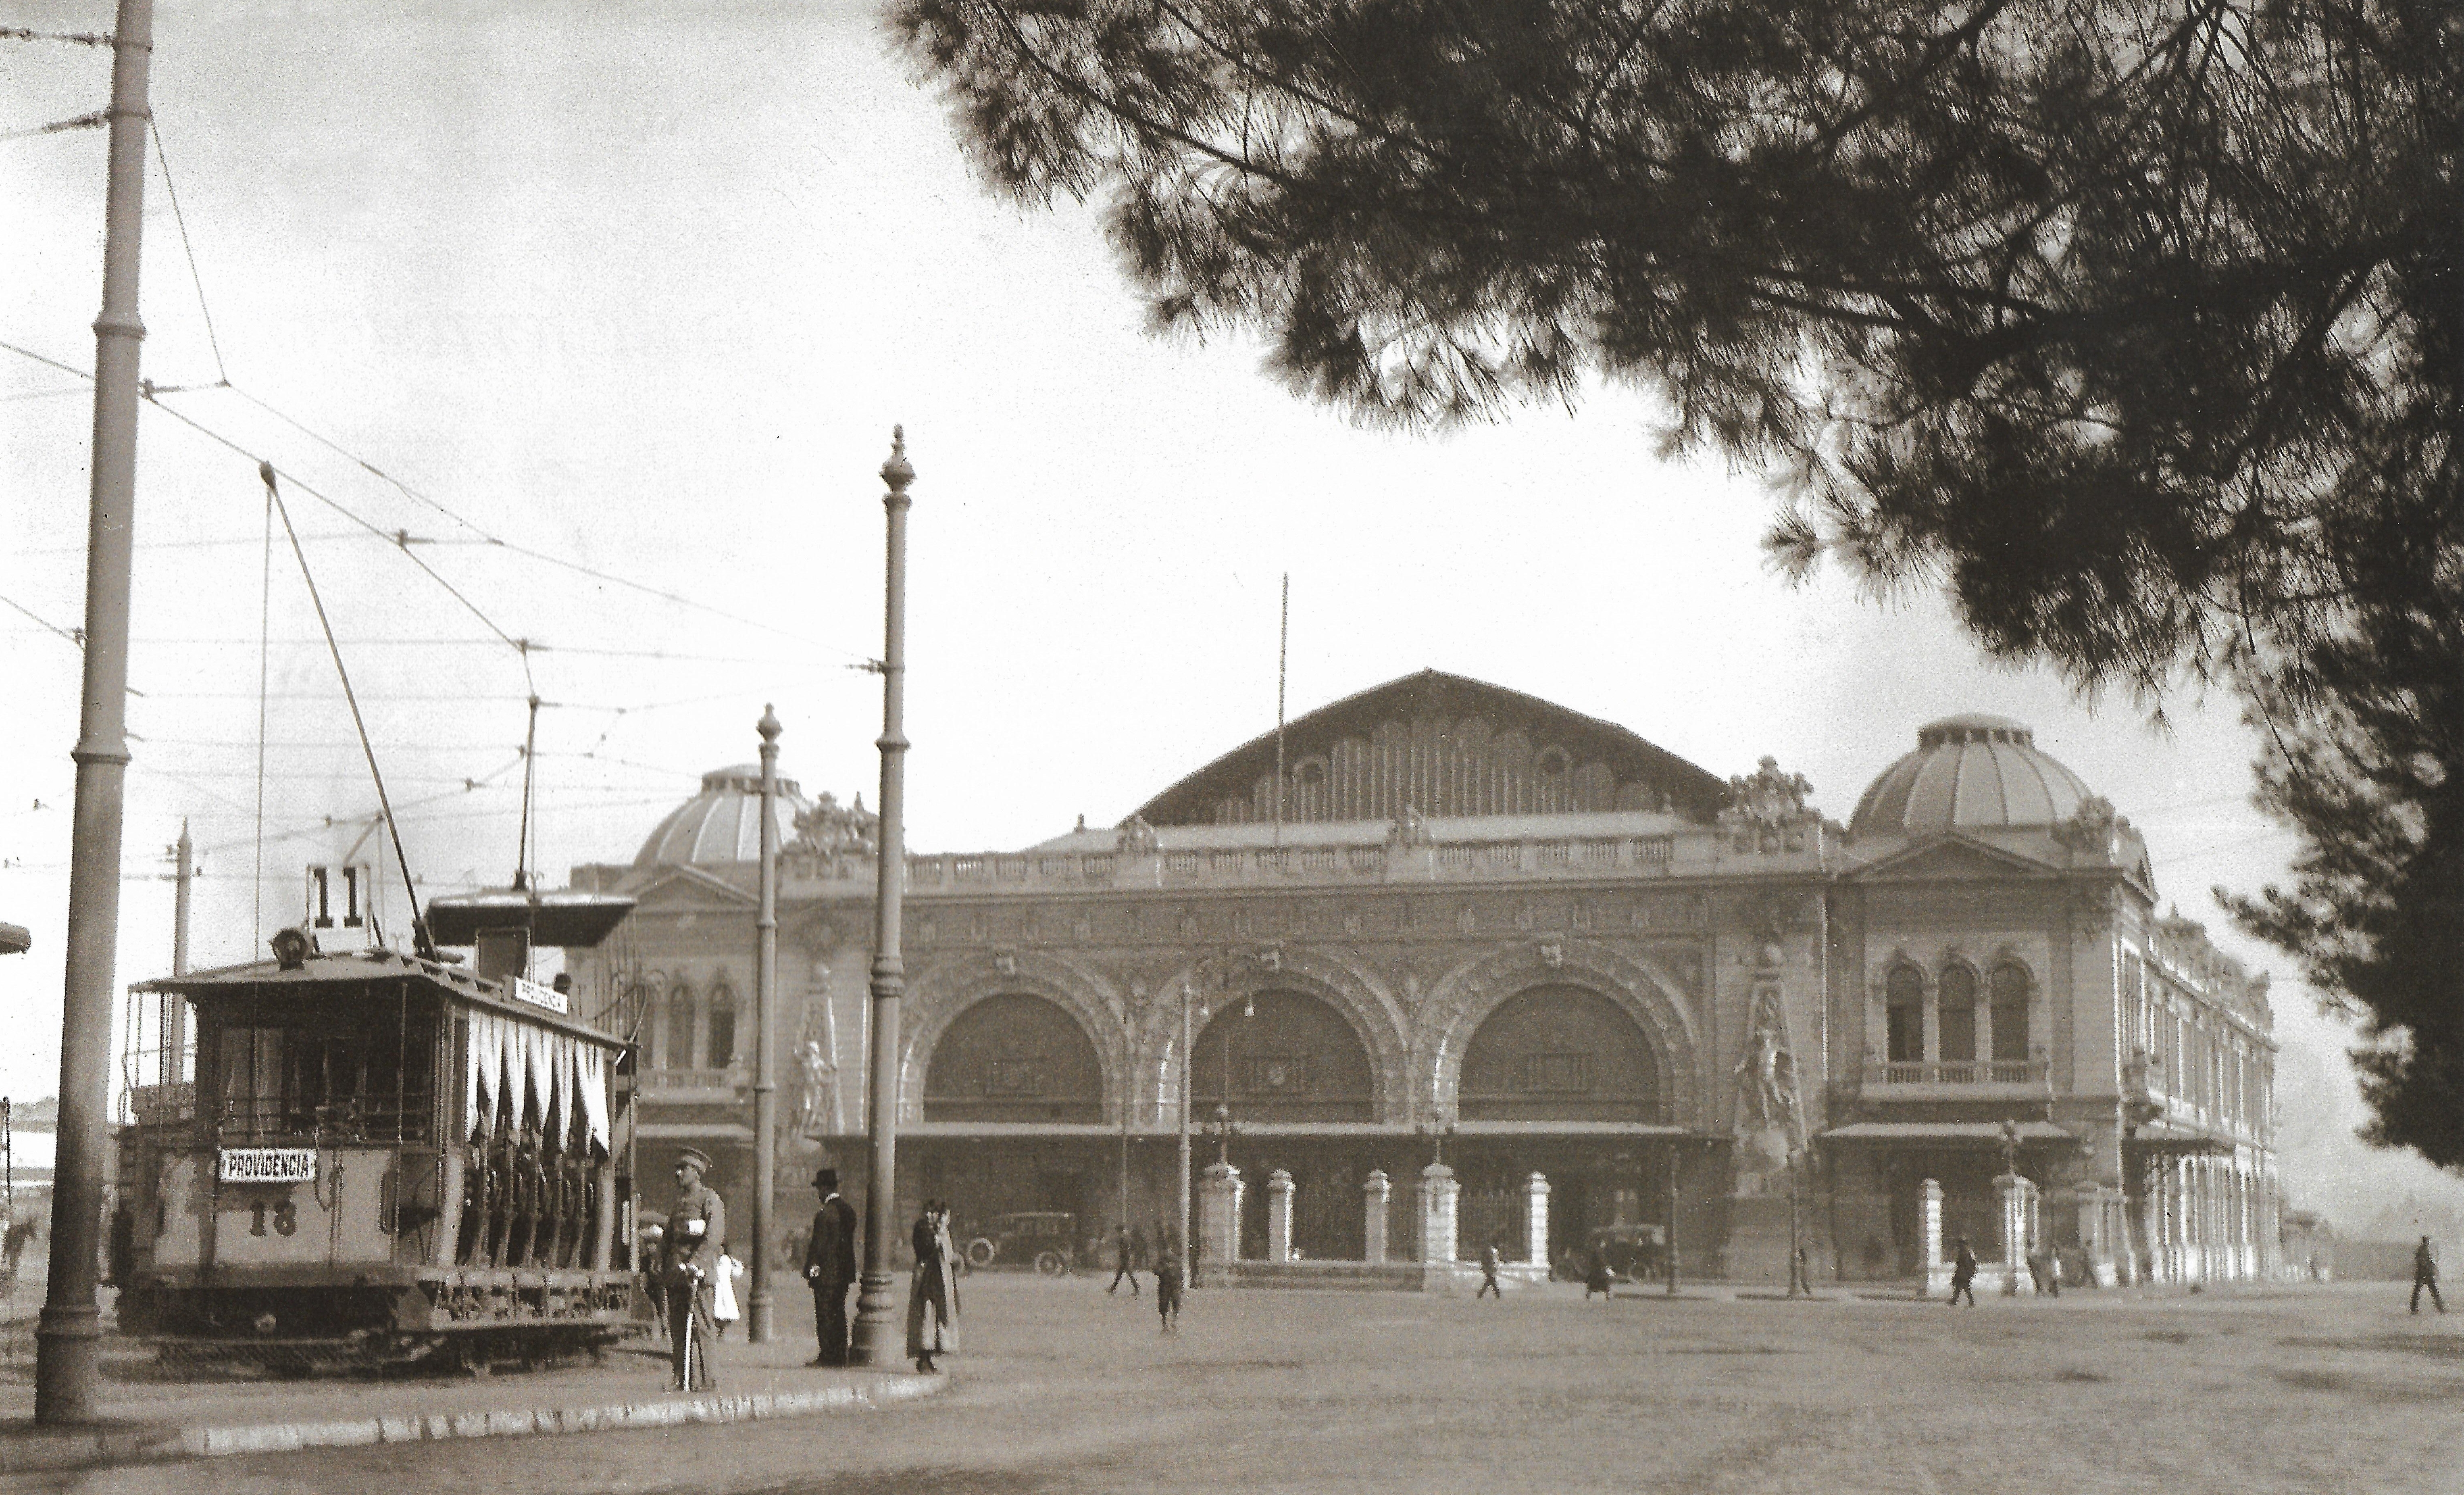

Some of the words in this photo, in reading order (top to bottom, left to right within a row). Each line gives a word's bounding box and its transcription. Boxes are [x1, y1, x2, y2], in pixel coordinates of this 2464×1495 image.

[314, 867, 362, 928] 11
[229, 1153, 309, 1177] PROVIDENCIA
[249, 1199, 297, 1237] 18
